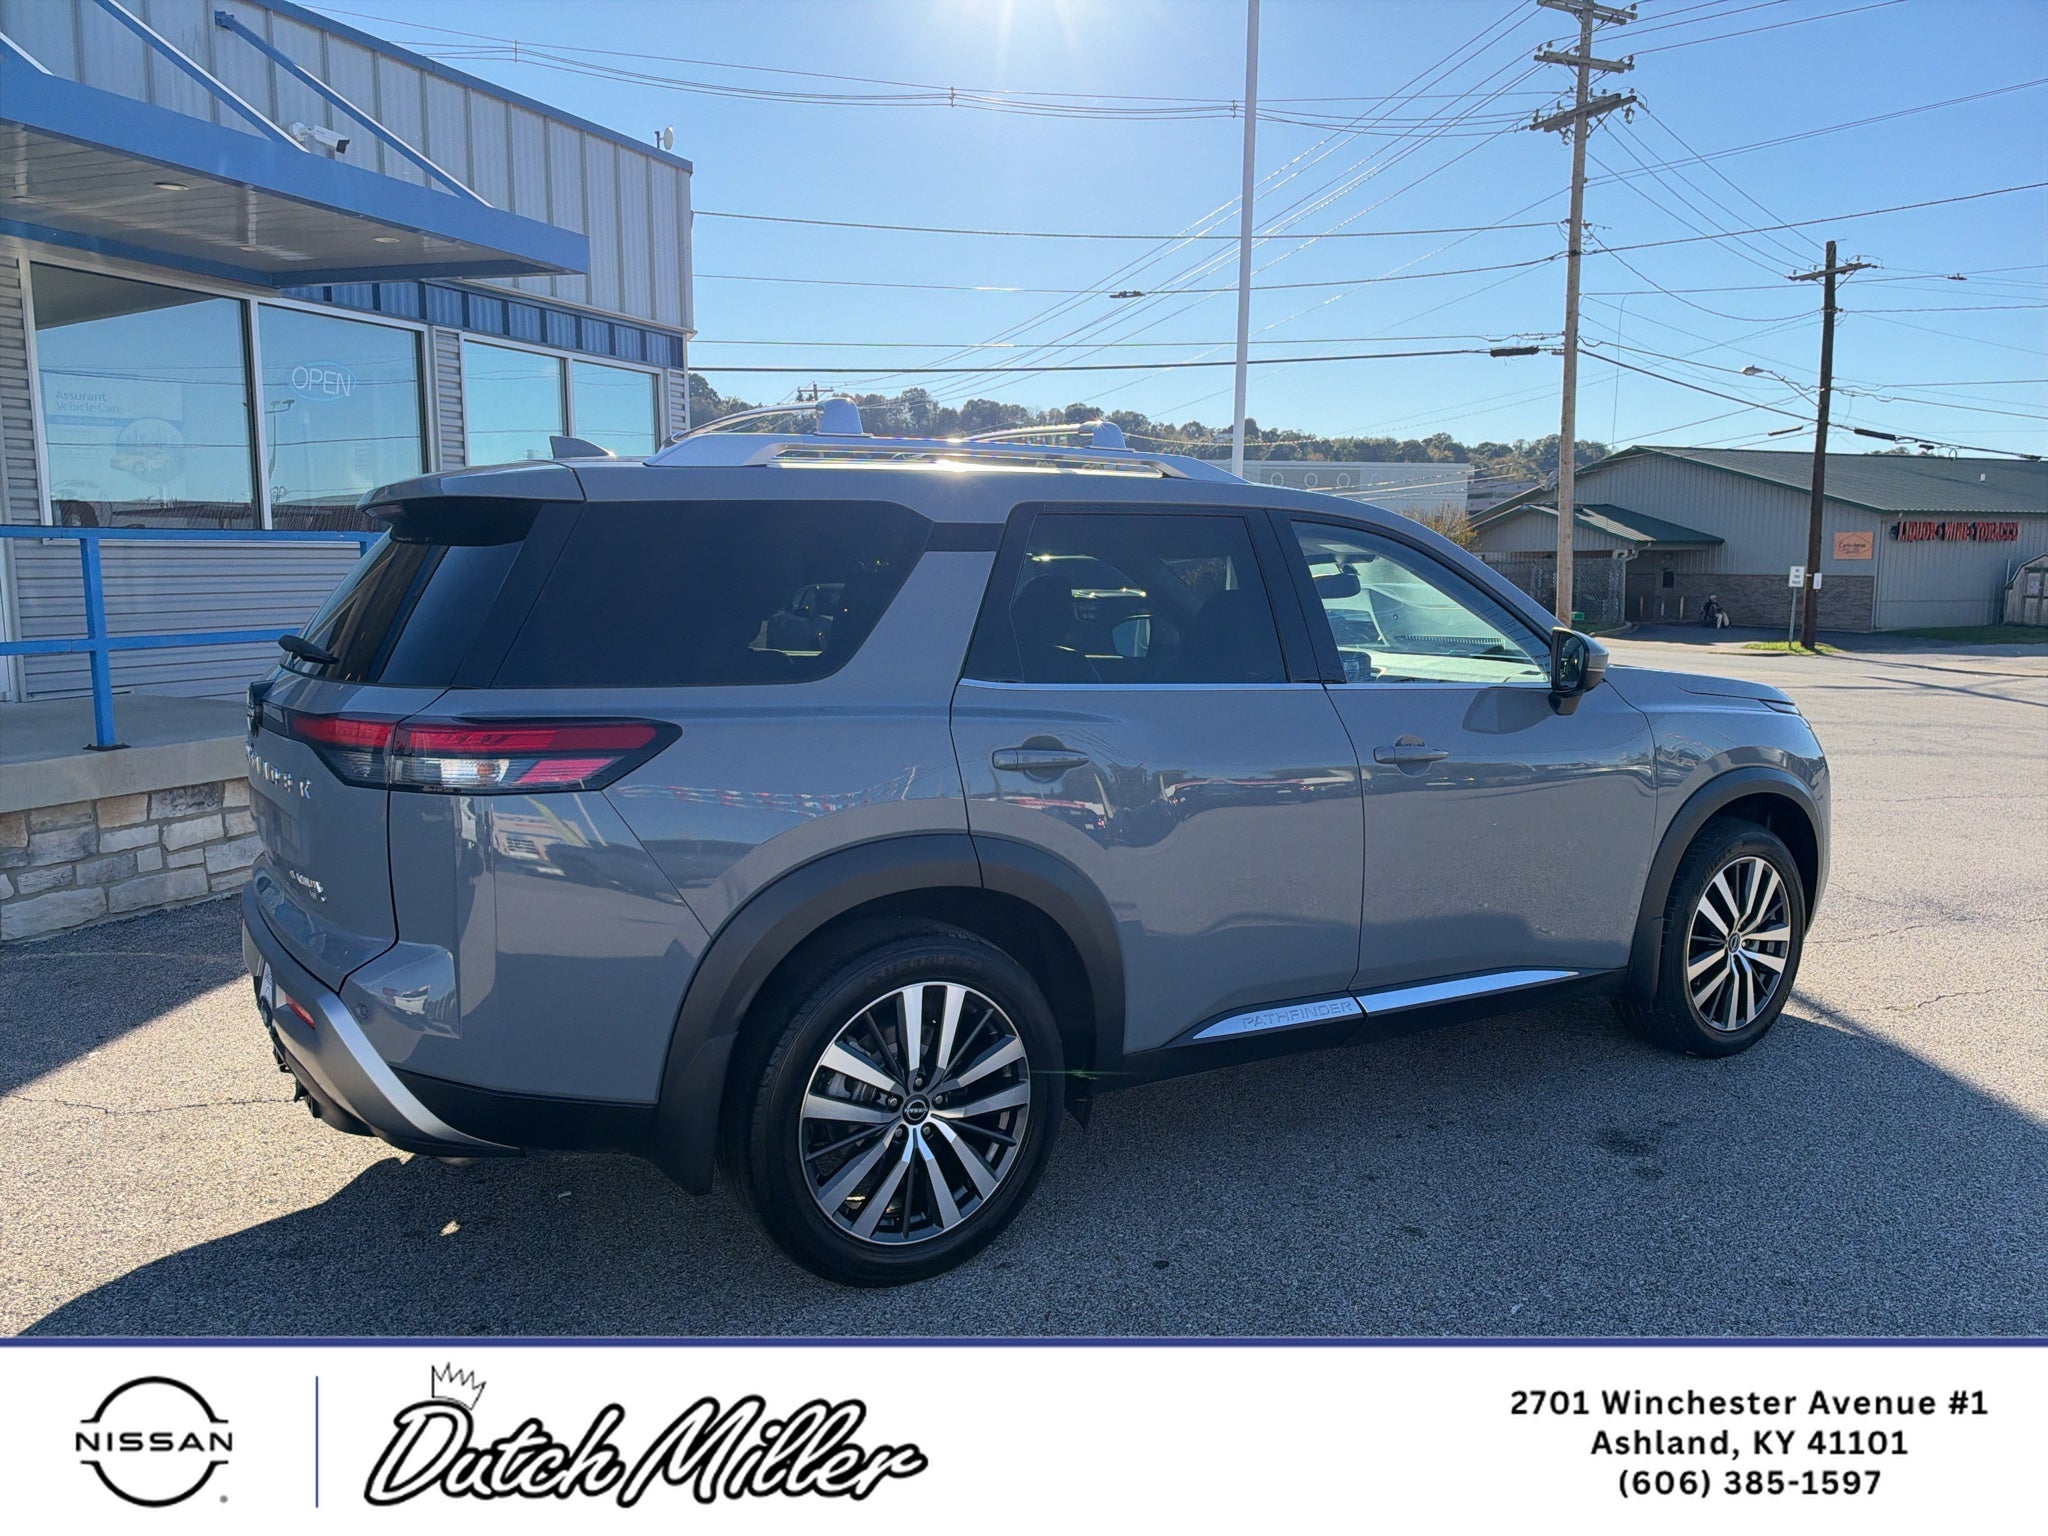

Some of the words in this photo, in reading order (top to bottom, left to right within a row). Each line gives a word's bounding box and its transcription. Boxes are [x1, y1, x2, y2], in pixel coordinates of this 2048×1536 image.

[291, 366, 351, 398] OPEN
[55, 390, 108, 402] Assurant
[56, 401, 96, 413] Vehicle
[97, 403, 125, 414] Care
[1898, 521, 1938, 543] LIQUOR
[1943, 521, 1970, 542] WINE
[1974, 521, 2019, 543] TOBACCO
[1242, 1001, 1353, 1029] PATHFINDER
